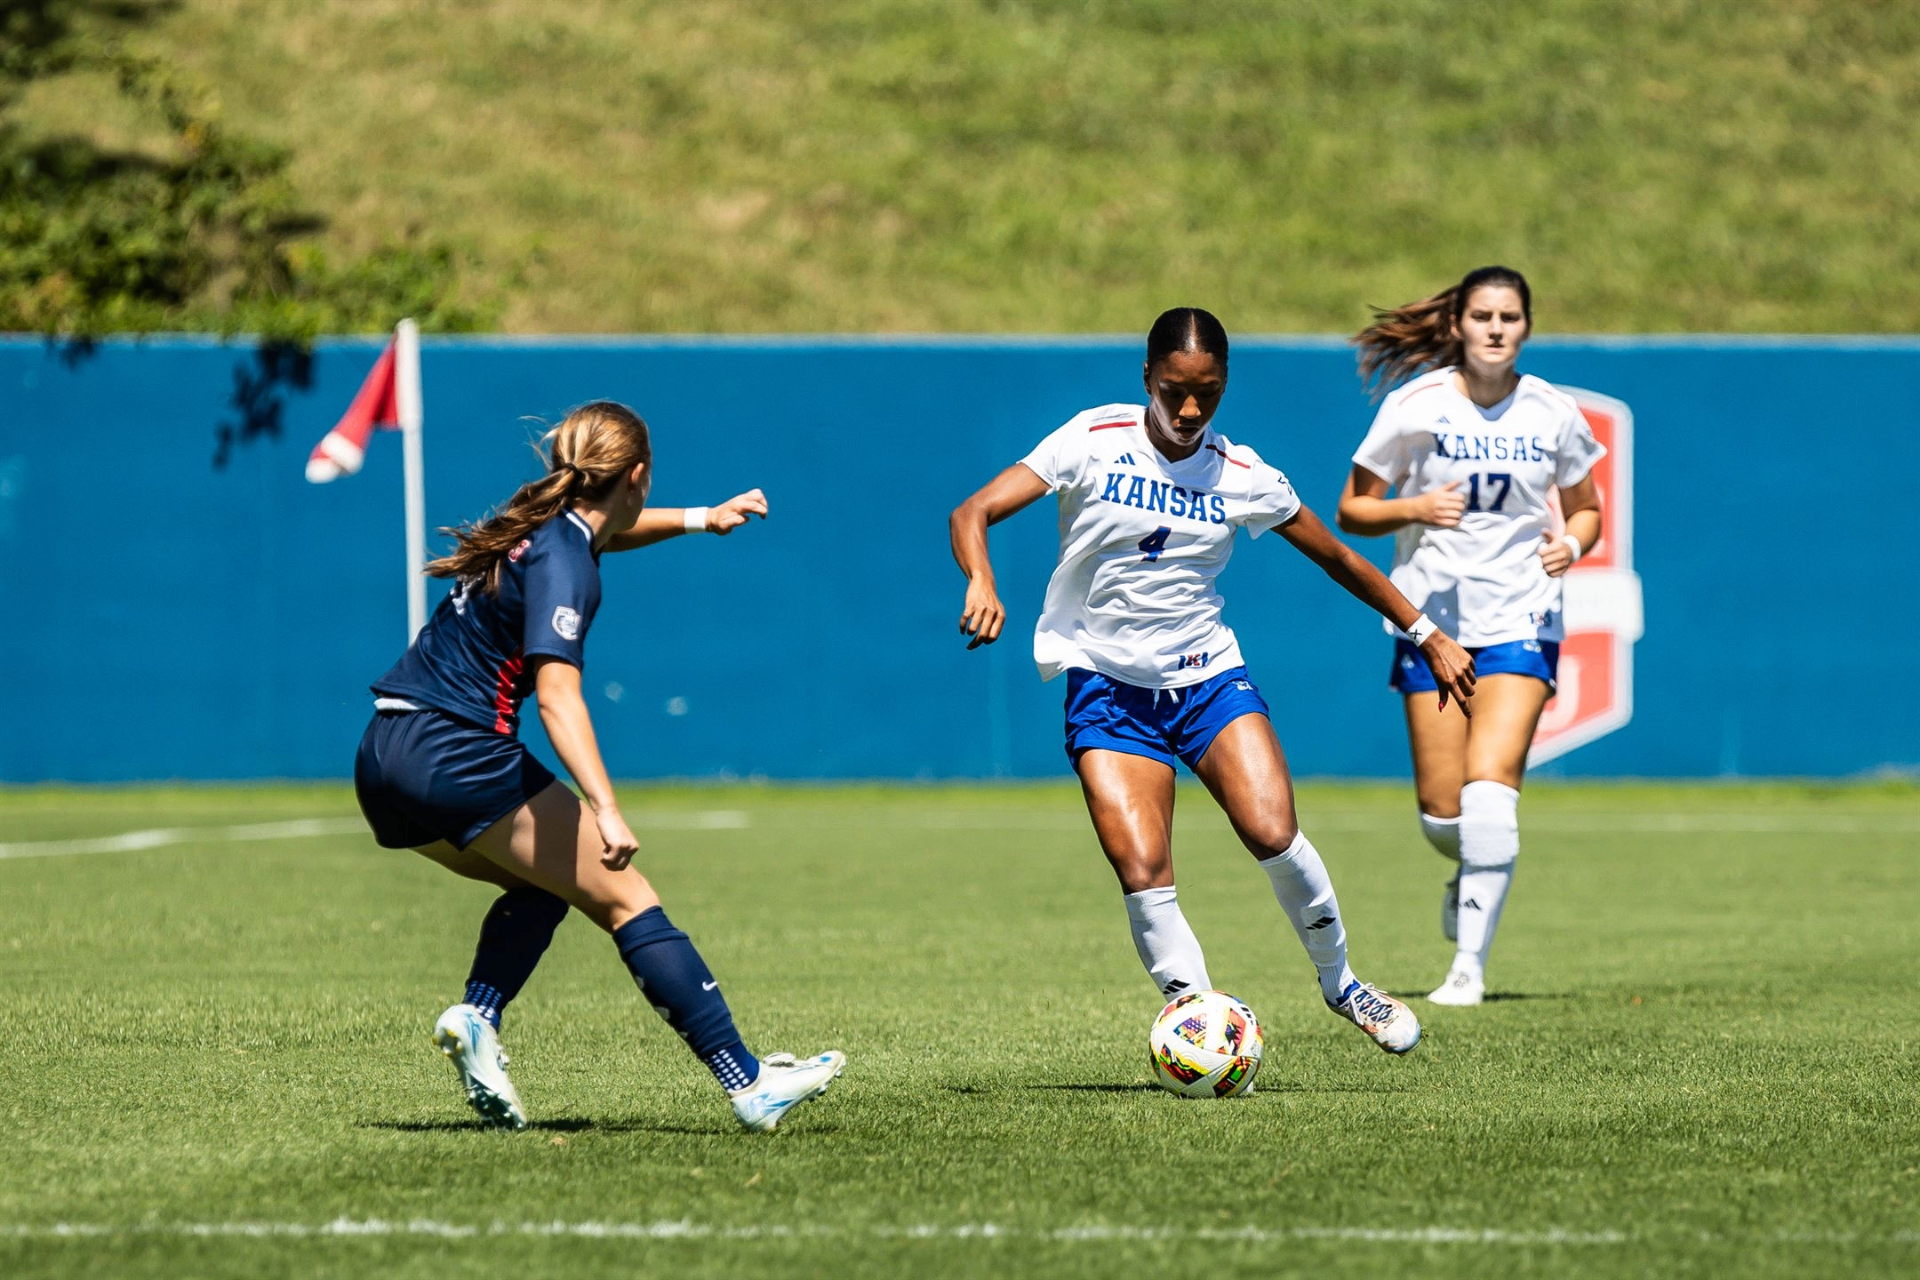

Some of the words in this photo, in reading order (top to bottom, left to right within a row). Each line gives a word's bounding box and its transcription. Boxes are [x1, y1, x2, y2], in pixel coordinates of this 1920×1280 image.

[1433, 433, 1544, 462] KANSAS
[1100, 472, 1226, 525] KANSAS
[1467, 472, 1512, 511] 17
[1138, 525, 1172, 563] 4
